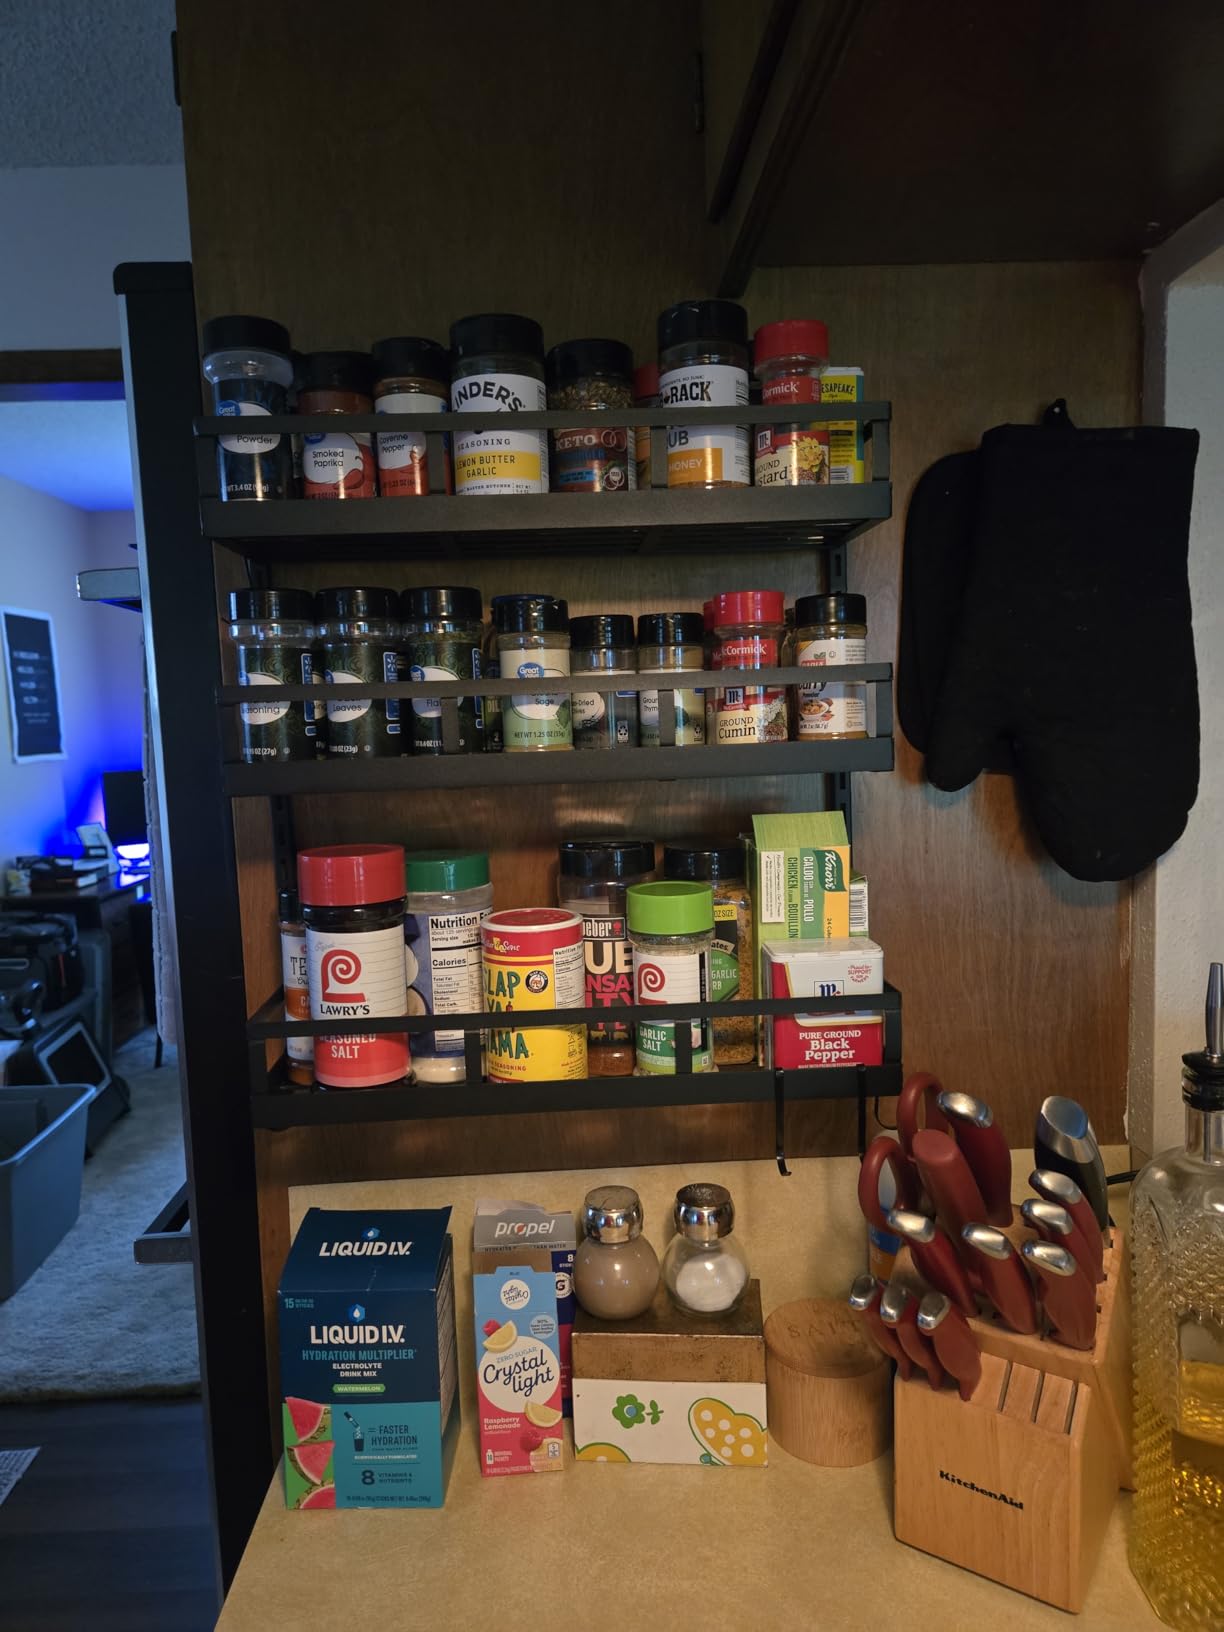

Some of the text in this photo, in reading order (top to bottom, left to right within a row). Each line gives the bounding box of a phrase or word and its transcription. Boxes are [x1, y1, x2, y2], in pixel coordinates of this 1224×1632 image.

[670, 381, 712, 403] RACK
[763, 381, 798, 398] Cormick
[821, 383, 855, 393] ESAPEAKE
[455, 382, 523, 412] INDER'S
[237, 435, 273, 444] Powder
[556, 435, 596, 450] KETO
[667, 430, 688, 449] UB
[313, 450, 344, 459] Smoked
[314, 459, 344, 468] Paprika
[457, 455, 515, 470] LEMON BUTTER
[669, 459, 704, 472] HONEY
[757, 459, 780, 474] OUND
[466, 467, 497, 478] GARLIC
[759, 466, 788, 486] stard
[519, 666, 539, 675] Great
[333, 703, 362, 712] Leaves
[535, 699, 554, 708] Sage
[719, 717, 753, 726] GROUND
[718, 725, 756, 738] Cumin
[788, 857, 798, 889] CHICKEN
[803, 856, 814, 880] CALDO
[825, 851, 836, 889] Knorr
[722, 909, 734, 917] SIZE
[804, 899, 814, 922] POLLO
[431, 916, 478, 929] Nutrition
[583, 919, 612, 937] eber
[788, 904, 798, 938] BOUILLON
[432, 958, 466, 967] Calories
[712, 968, 737, 979] GARLIC
[484, 969, 520, 998] LAP
[586, 974, 633, 992] NSA
[586, 992, 634, 1008] ITY
[320, 1004, 370, 1016] LAWRY'S
[639, 1026, 666, 1041] GARLIC
[799, 1030, 861, 1040] PURE GROUND
[331, 1045, 360, 1059] SALT
[490, 1031, 529, 1059] AMA
[642, 1038, 661, 1052] SALT
[810, 1039, 850, 1050] Black
[804, 1049, 855, 1063] Pepper
[495, 1220, 555, 1238] propel
[319, 1241, 412, 1256] LIQUID I.V.
[568, 1254, 573, 1262] 8
[285, 1298, 294, 1308] 15
[310, 1325, 405, 1344] LIQUID I.V.
[302, 1349, 414, 1361] HYDRATION MULTIPLIER
[496, 1347, 538, 1363] ZERO SUGAR
[483, 1349, 547, 1385] Crystal
[512, 1367, 554, 1397] light
[379, 1425, 409, 1434] FASTER
[371, 1435, 418, 1445] HYDRATION
[361, 1469, 375, 1486] 8
[939, 1470, 1024, 1510] KitchenAid
